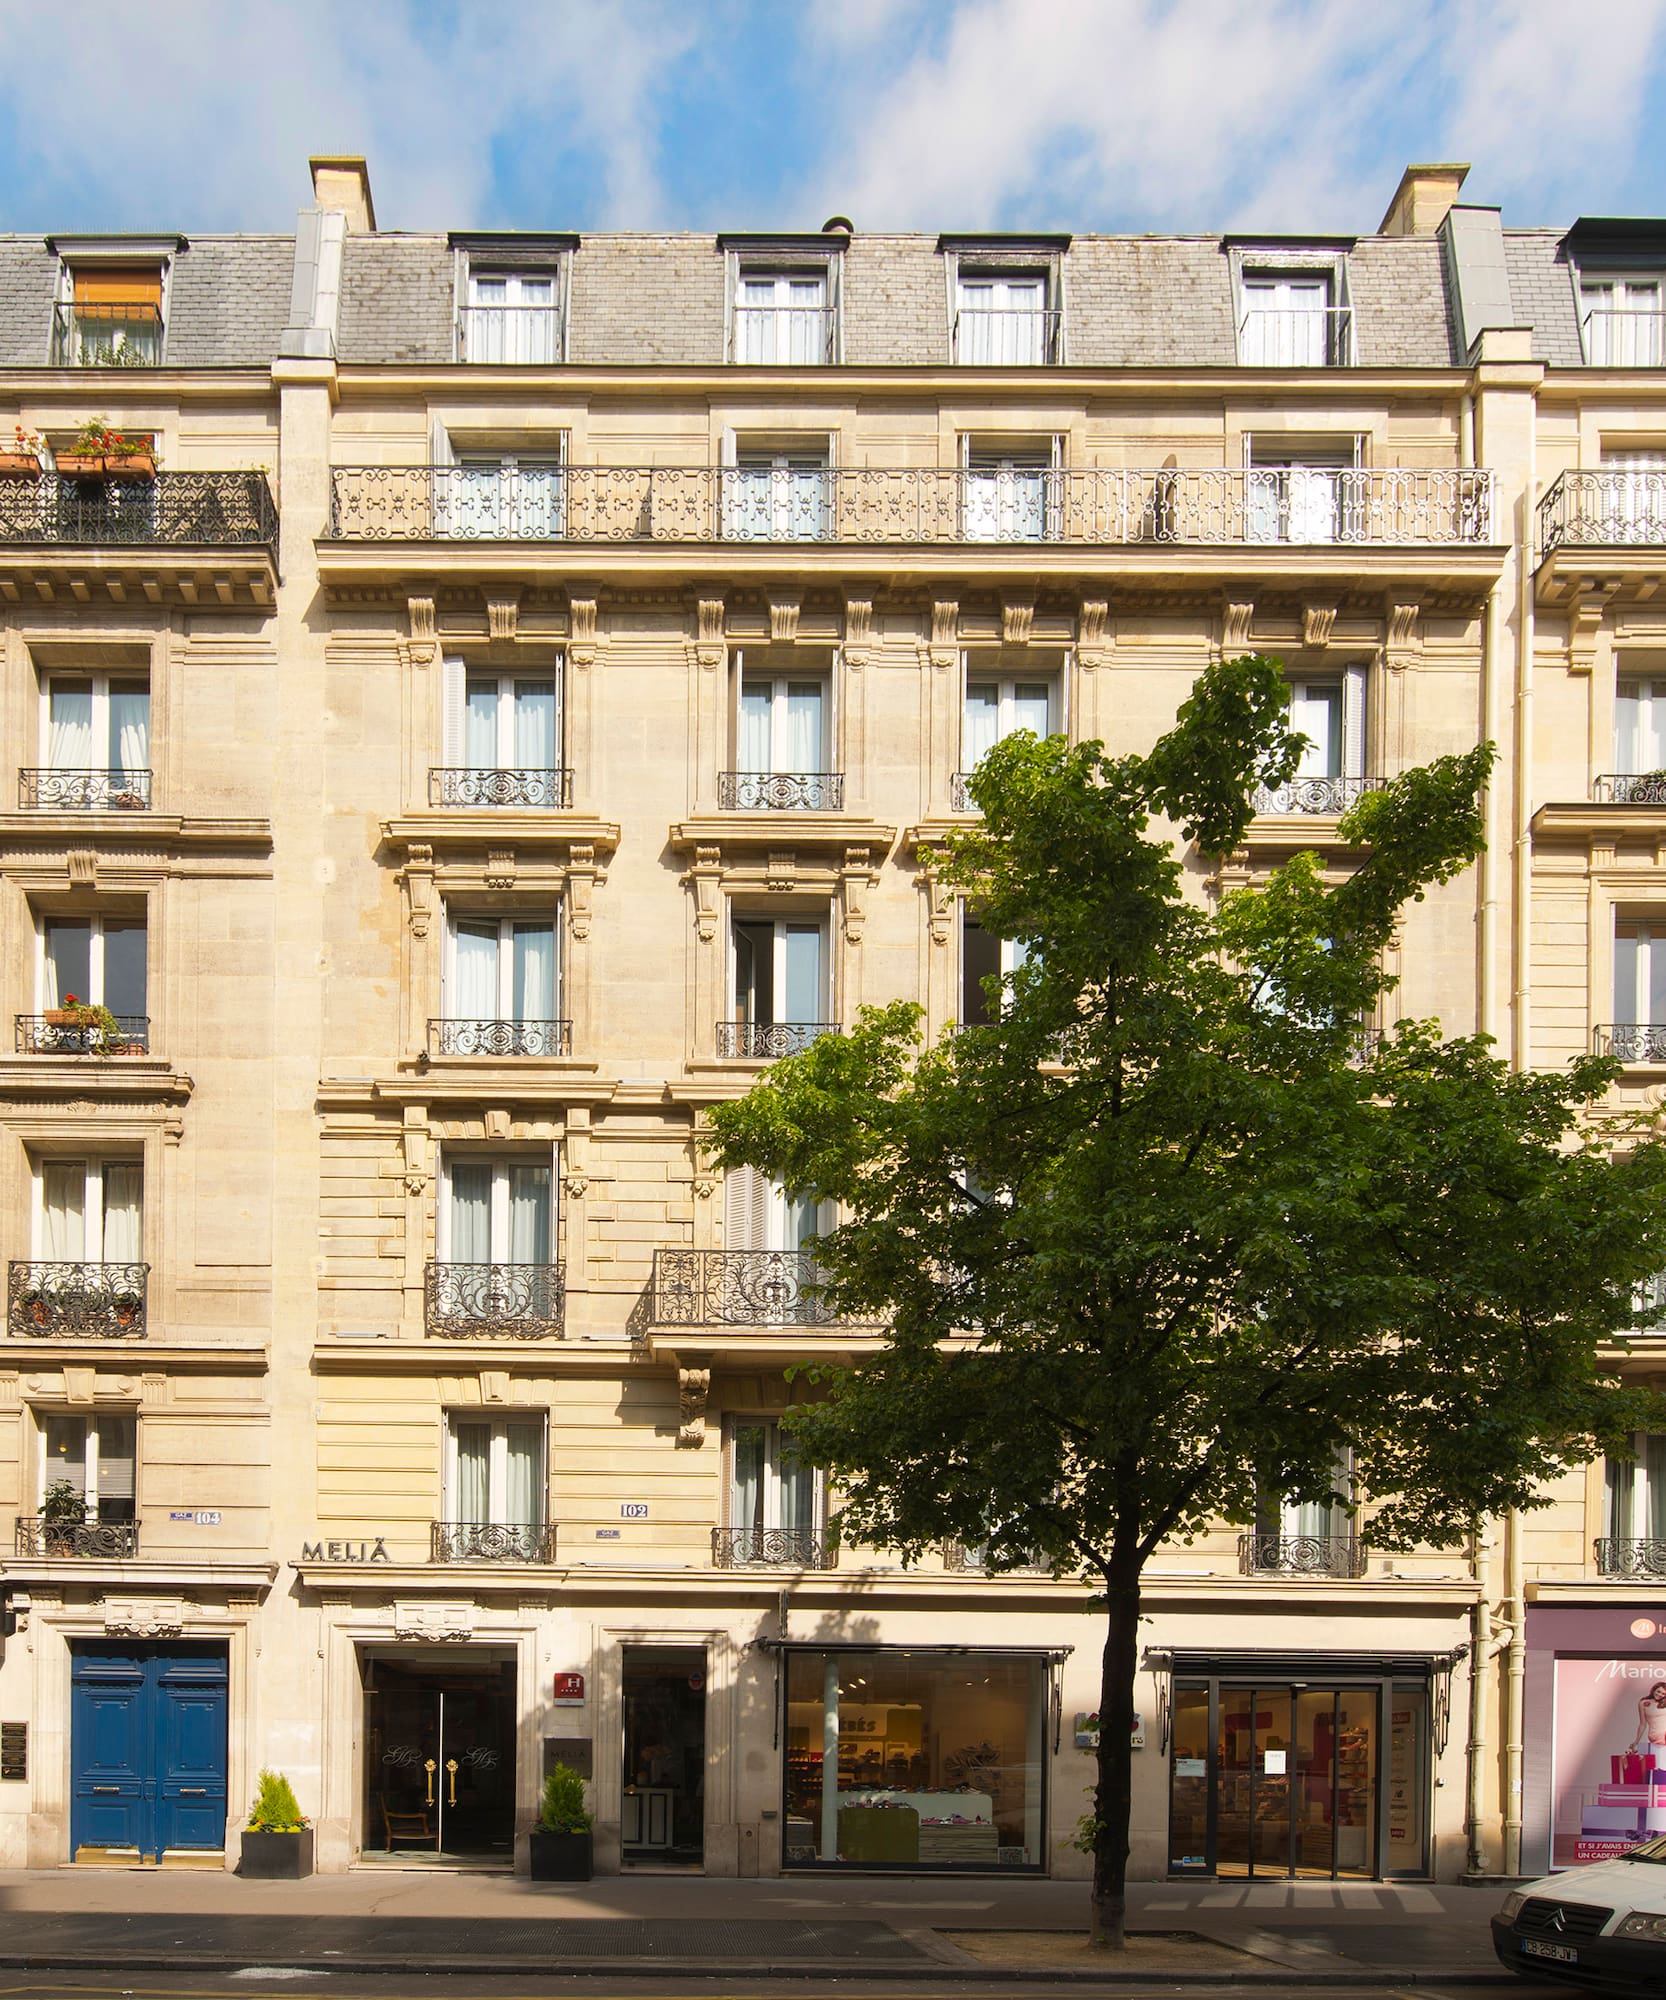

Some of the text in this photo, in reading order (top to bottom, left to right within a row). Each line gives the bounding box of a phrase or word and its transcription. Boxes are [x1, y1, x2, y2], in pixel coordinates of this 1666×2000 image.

[195, 1511, 220, 1524] 104
[622, 1504, 647, 1518] 102
[568, 1678, 580, 1688] H
